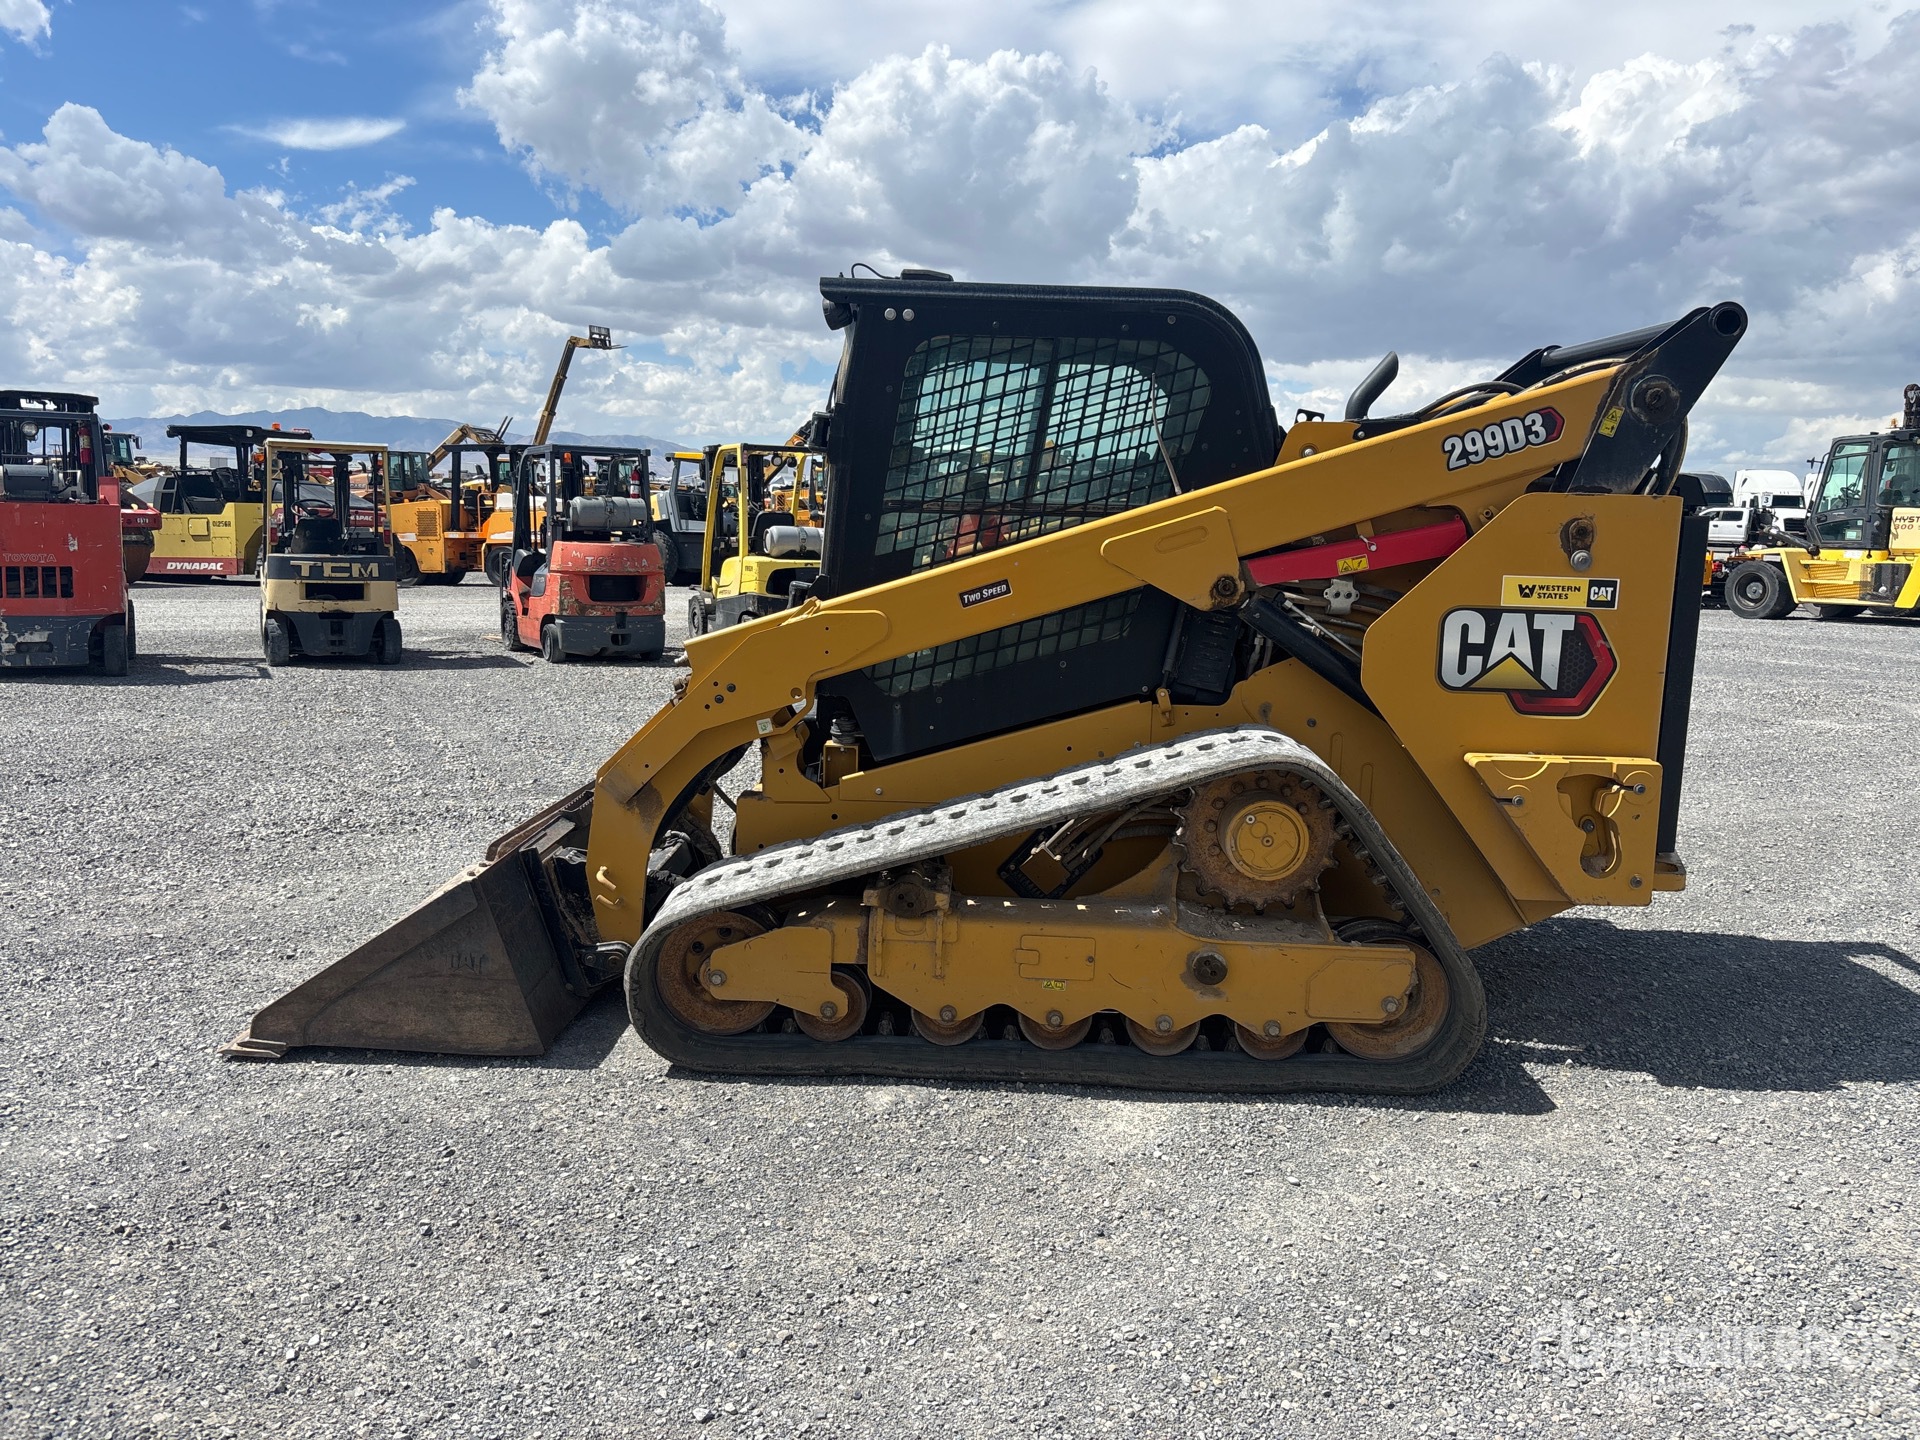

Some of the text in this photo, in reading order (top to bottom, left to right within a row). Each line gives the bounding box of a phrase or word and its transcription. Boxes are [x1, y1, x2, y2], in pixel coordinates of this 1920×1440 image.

[1444, 412, 1548, 469] 299D3
[3, 553, 57, 563] TOYOTA
[166, 561, 224, 571] DYNAPAC
[290, 560, 379, 578] TCM
[1537, 584, 1581, 593] WESTERN
[1590, 586, 1613, 601] CAT
[1536, 592, 1569, 600] STATES
[1441, 610, 1576, 691] CAT
